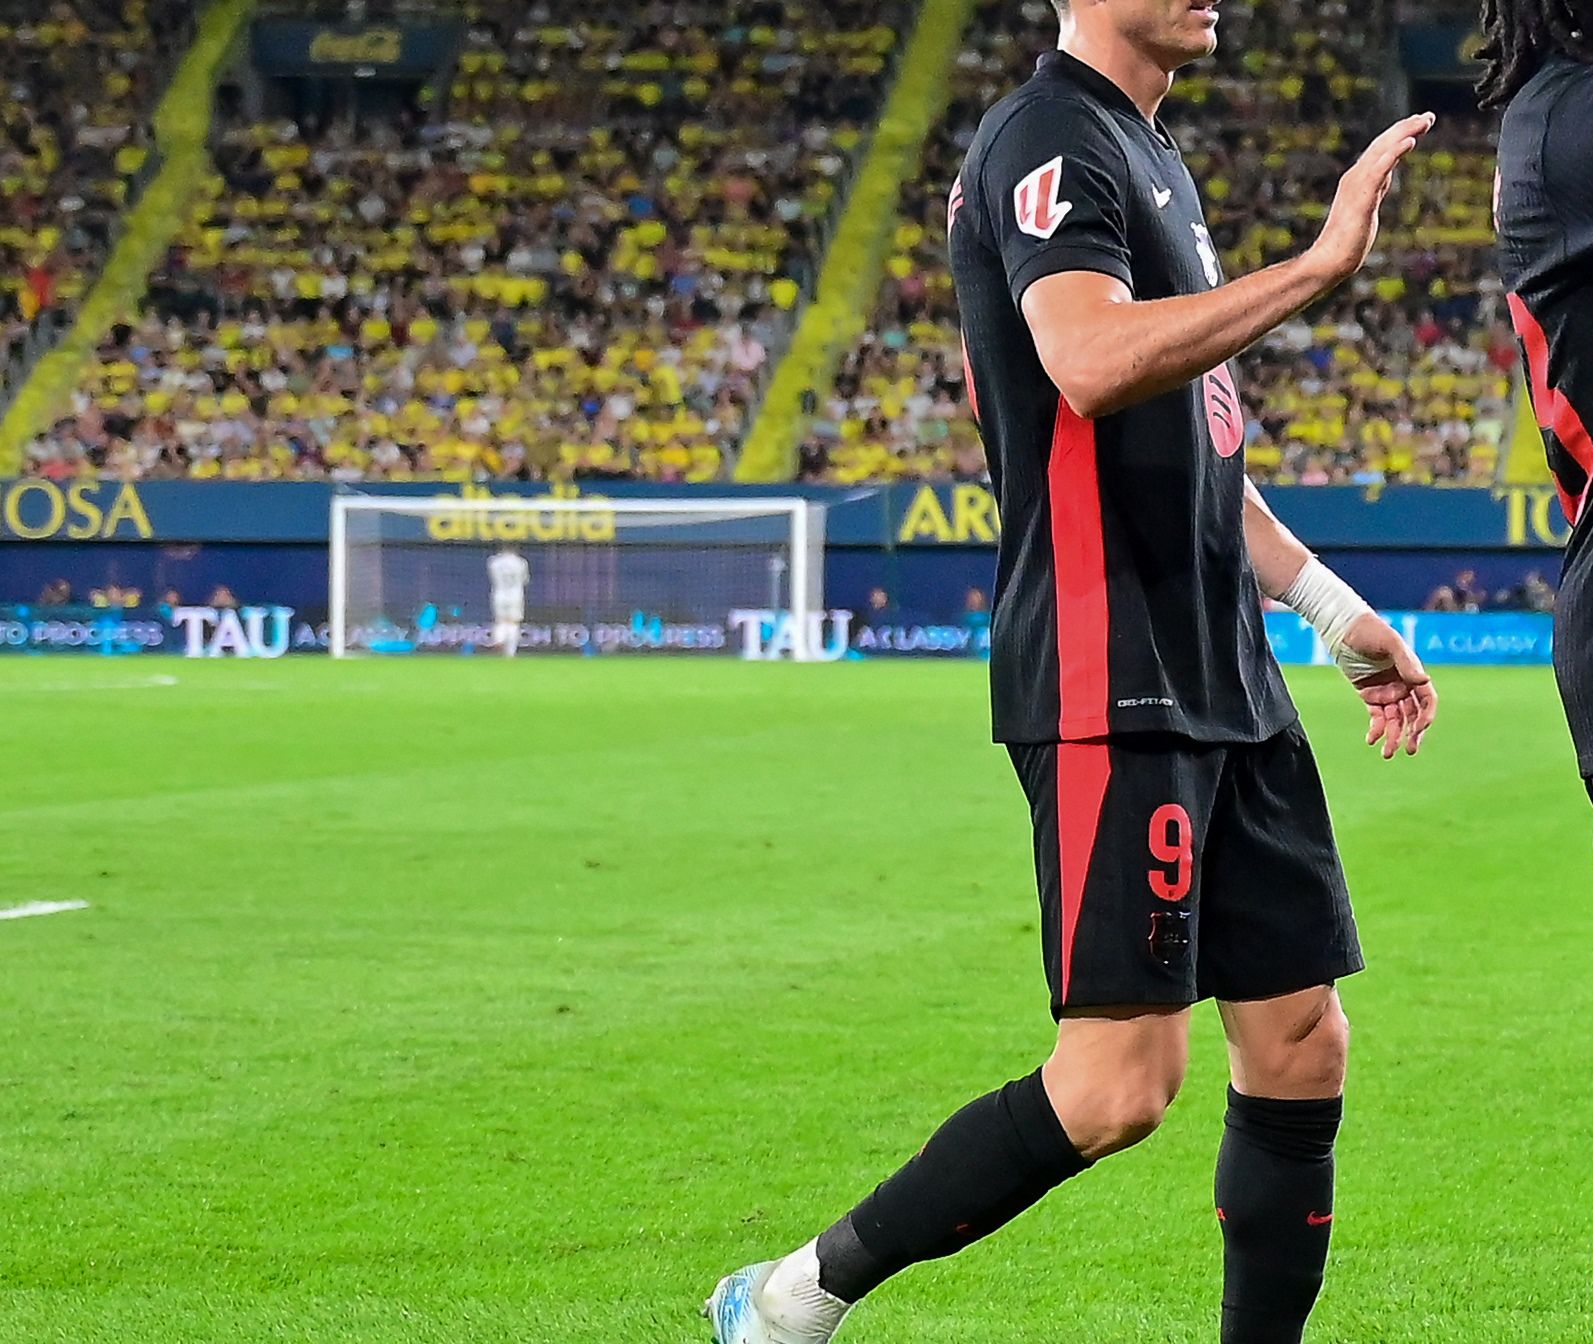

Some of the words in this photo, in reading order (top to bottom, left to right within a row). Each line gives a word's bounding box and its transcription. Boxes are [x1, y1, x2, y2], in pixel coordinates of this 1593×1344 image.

[5, 478, 154, 540] OSA
[428, 478, 616, 541] altadia
[172, 605, 296, 659] TAU
[728, 608, 854, 661] TAU
[1148, 803, 1194, 902] 9
